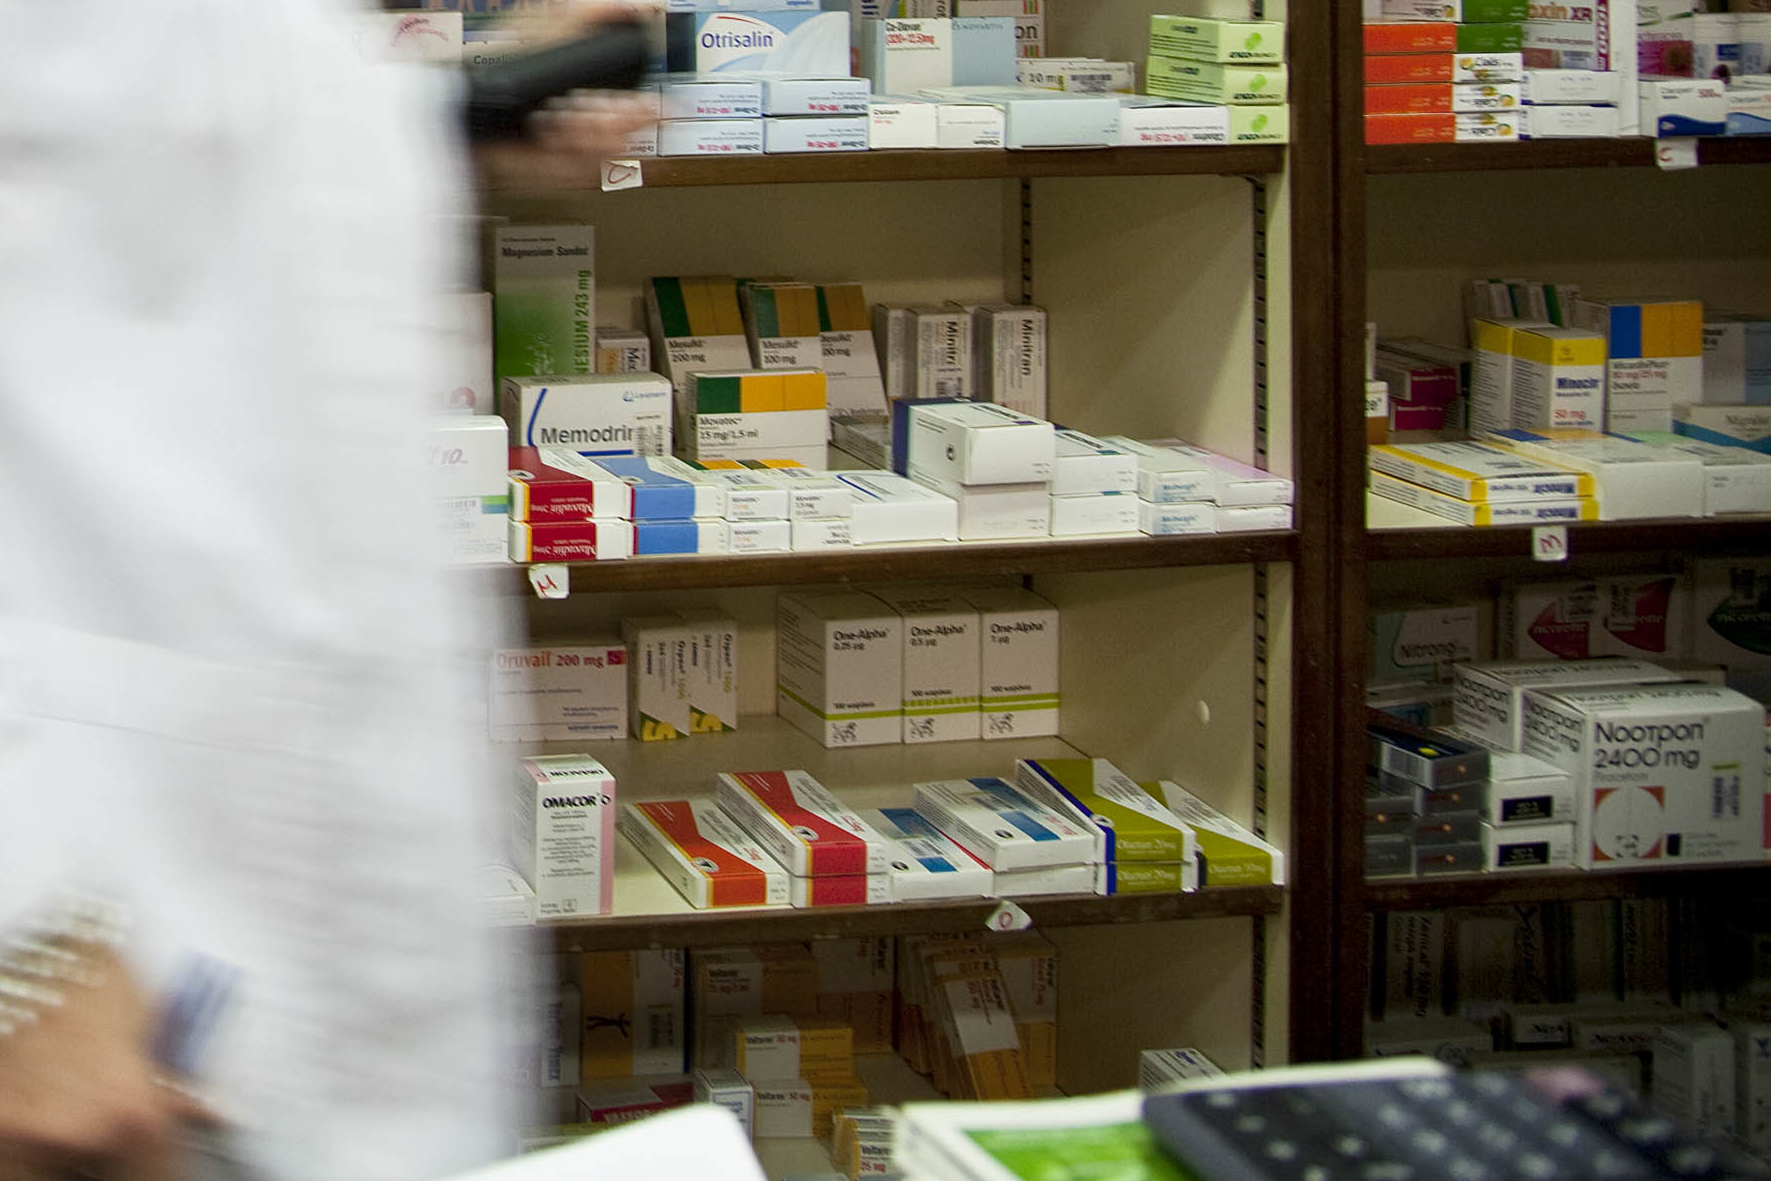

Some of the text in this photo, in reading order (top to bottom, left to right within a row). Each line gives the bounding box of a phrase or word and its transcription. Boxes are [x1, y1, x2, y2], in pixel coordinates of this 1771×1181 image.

[701, 31, 773, 49] Otrisalin
[556, 655, 579, 667] 200
[584, 656, 604, 668] mg
[1595, 749, 1701, 768] 2400 mg
[542, 794, 596, 808] OMACOR
